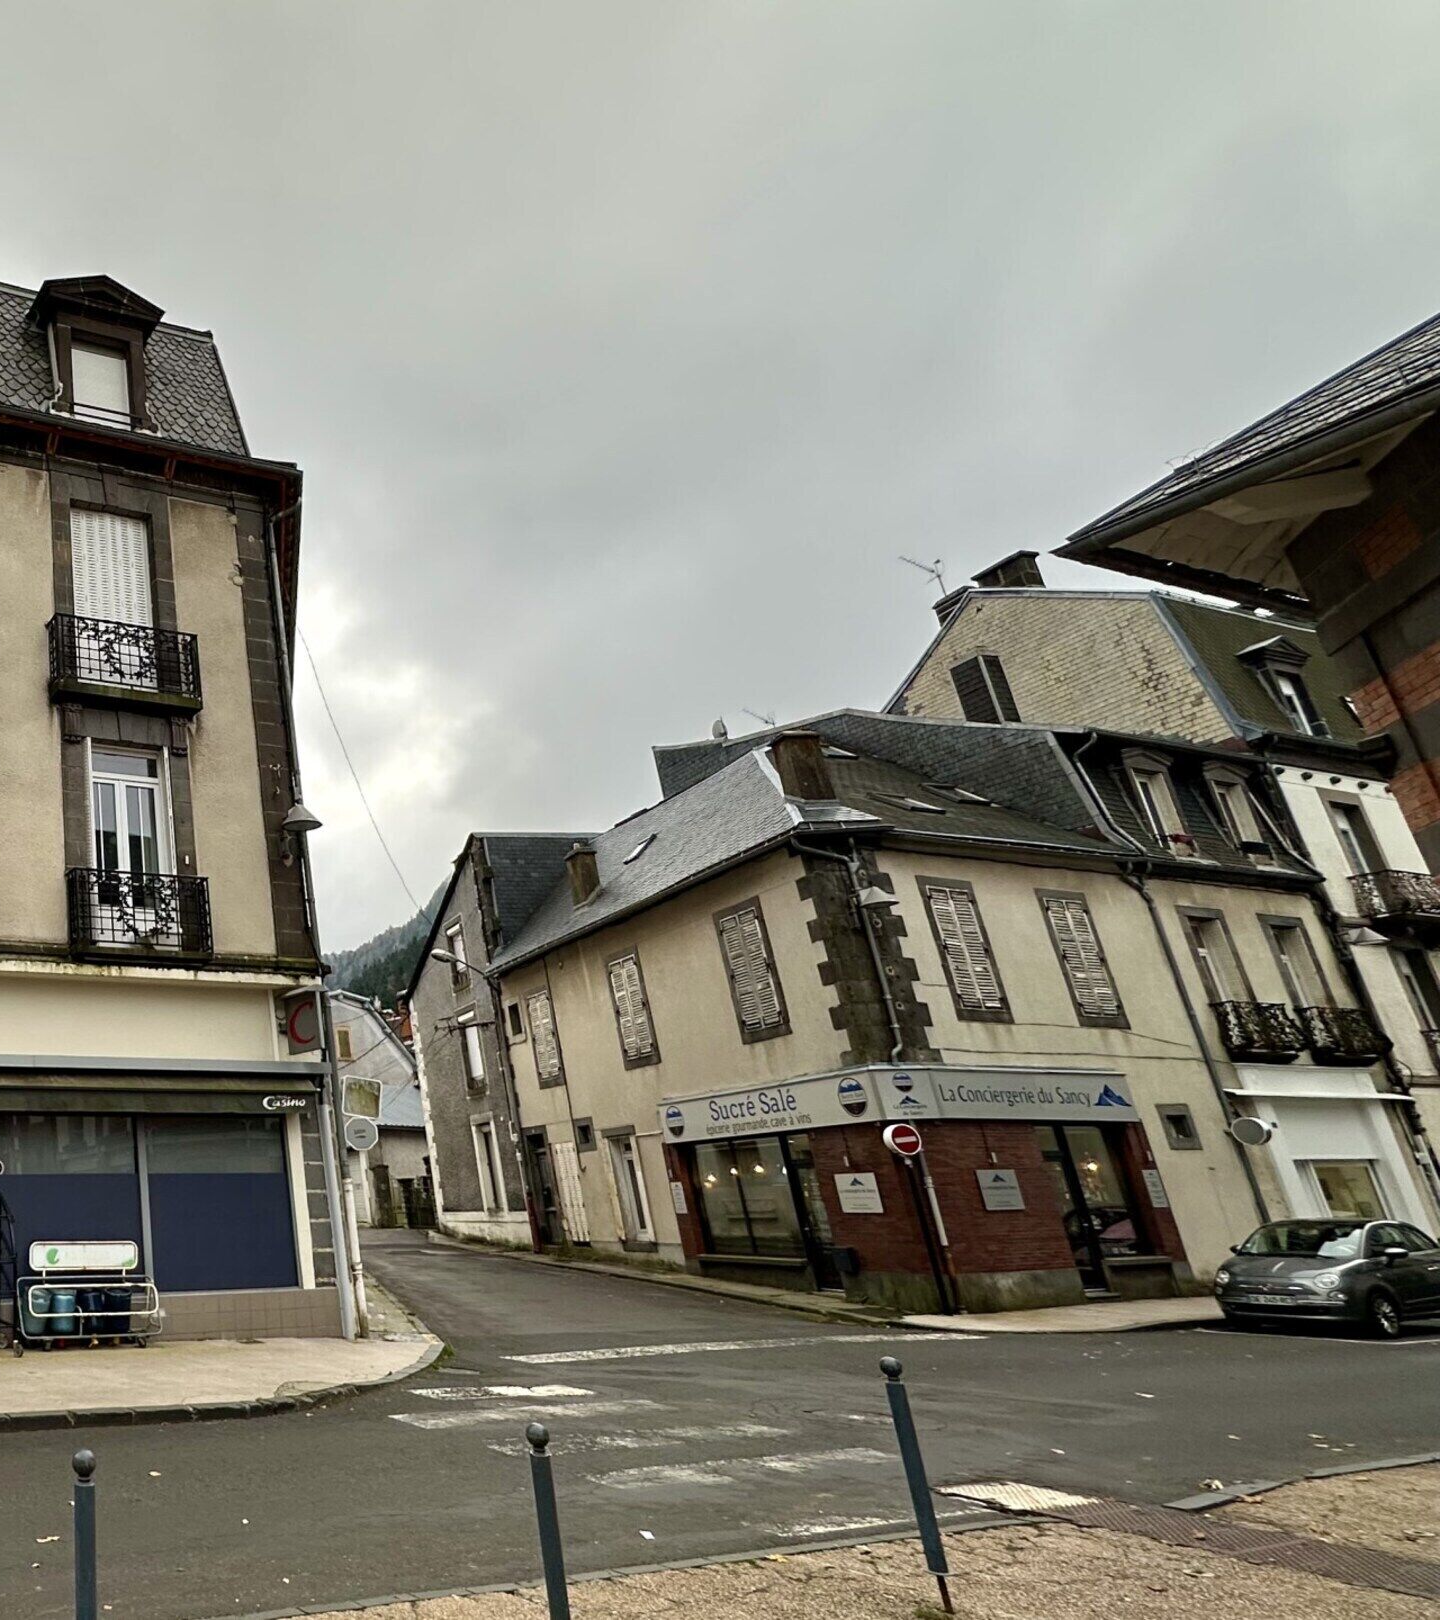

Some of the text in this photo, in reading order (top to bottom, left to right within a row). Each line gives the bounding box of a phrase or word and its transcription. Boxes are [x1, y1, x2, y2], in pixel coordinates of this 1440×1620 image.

[262, 1095, 306, 1110] Casino
[709, 1088, 797, 1121] Sucré Salé
[938, 1084, 1090, 1107] La Conciergerie du Sancy
